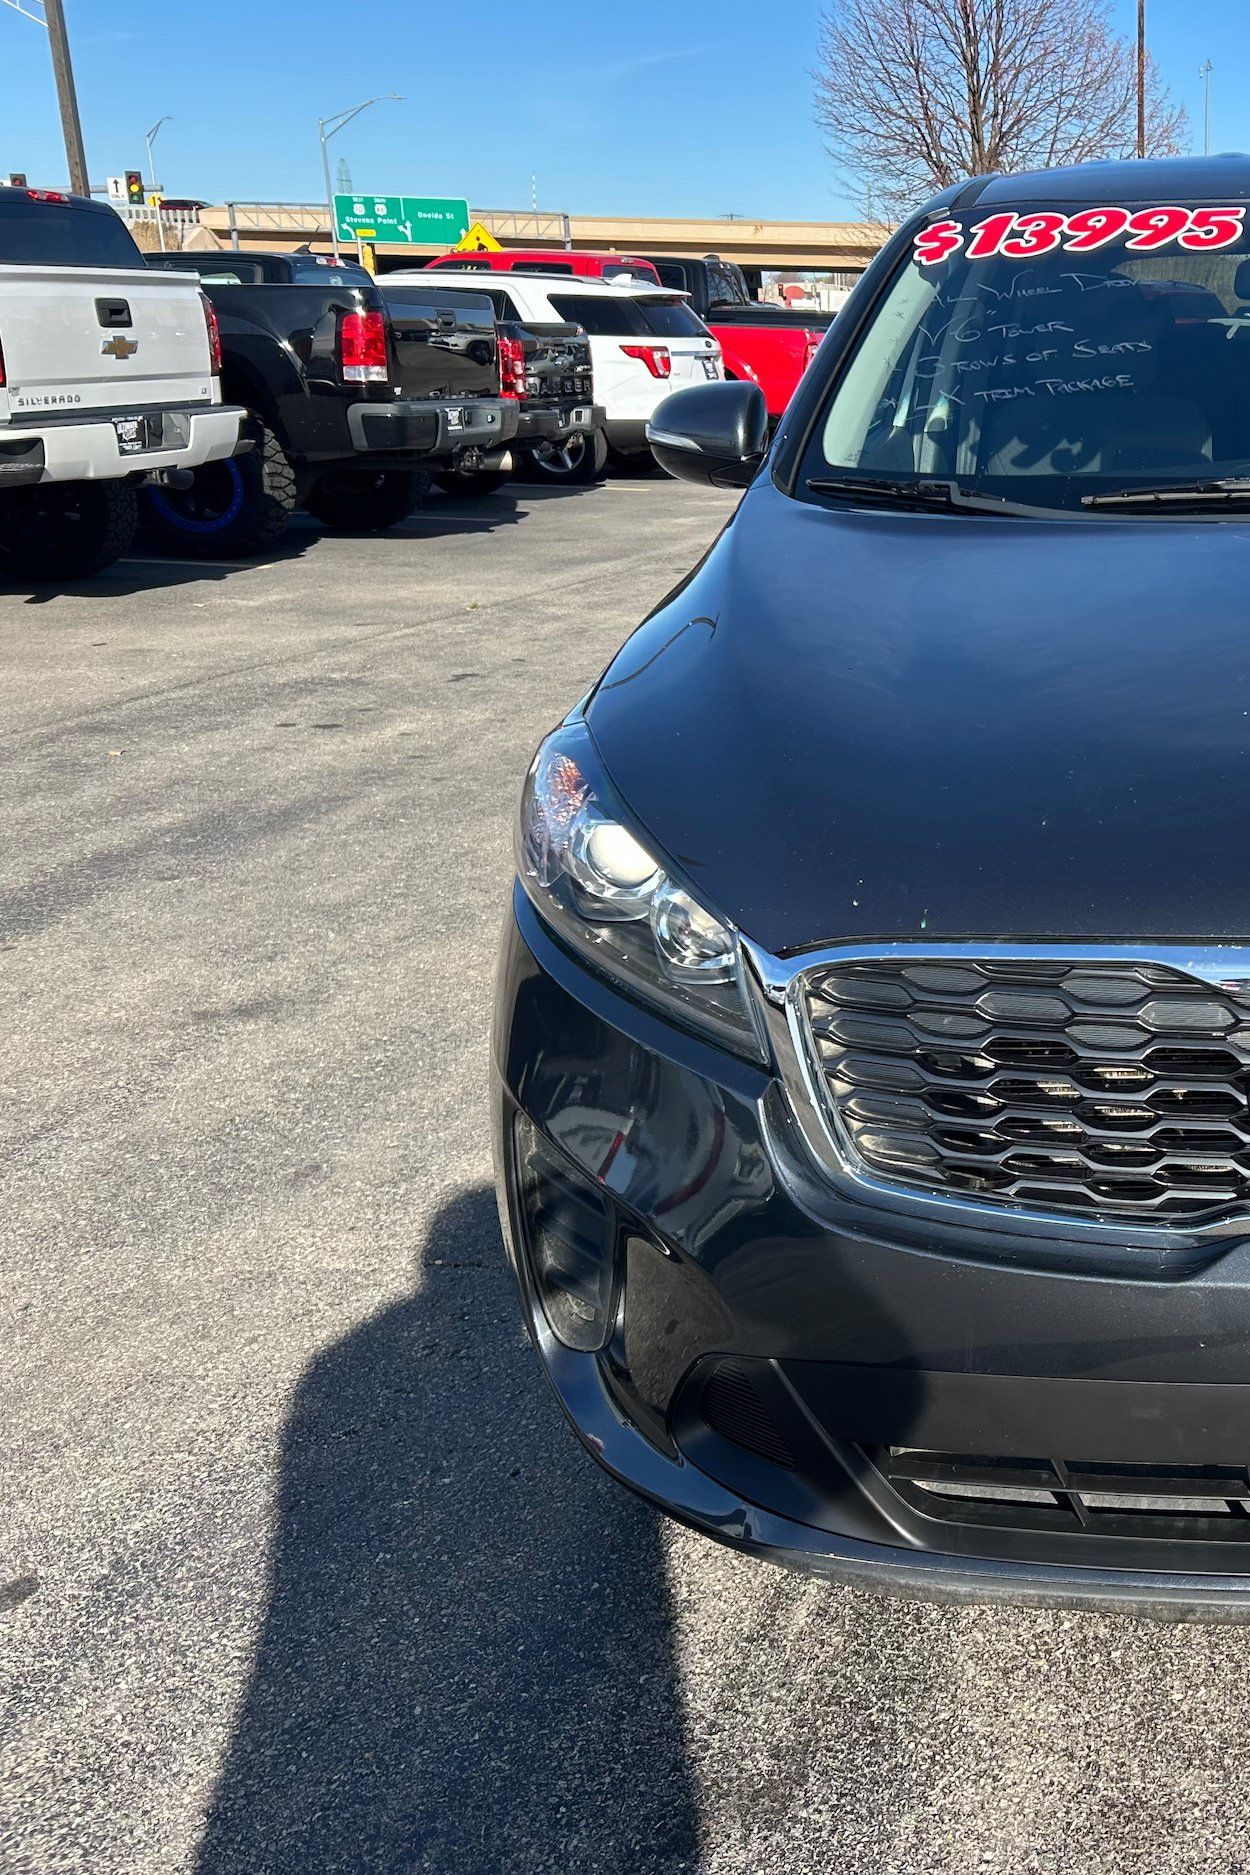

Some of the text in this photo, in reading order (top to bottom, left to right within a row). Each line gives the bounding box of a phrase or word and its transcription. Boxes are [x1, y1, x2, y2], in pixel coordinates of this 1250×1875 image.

[345, 216, 374, 224] Stevens
[446, 212, 455, 220] St
[913, 206, 1246, 266] $13995
[1034, 374, 1134, 396] PACKAGE
[18, 394, 81, 406] SILVERADO
